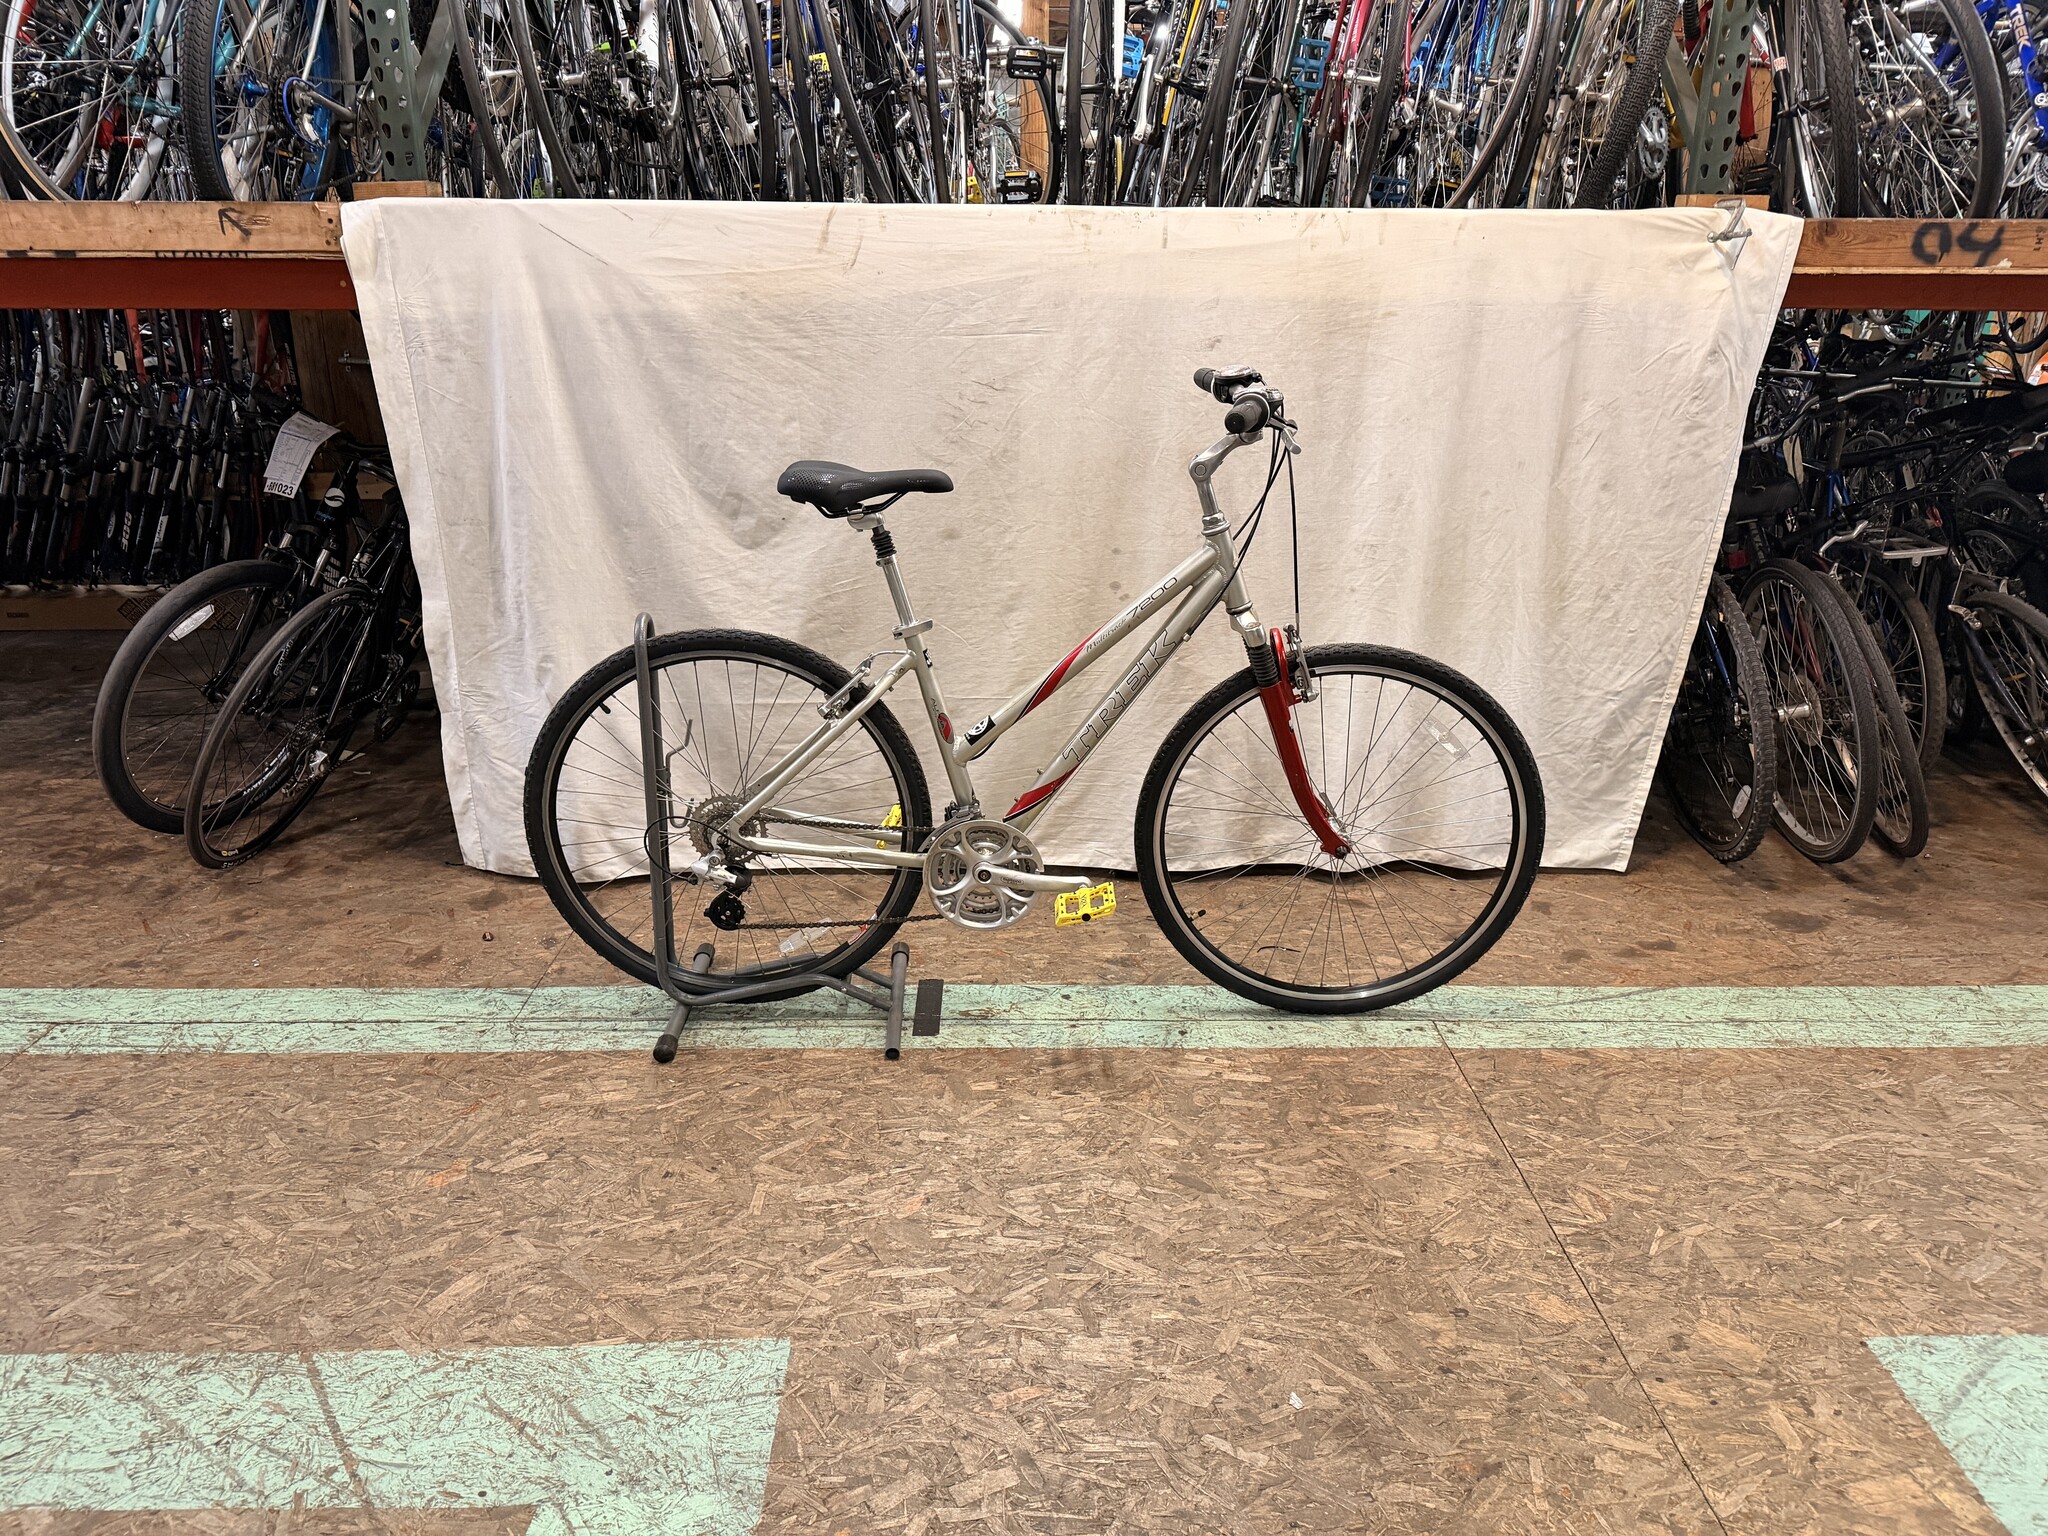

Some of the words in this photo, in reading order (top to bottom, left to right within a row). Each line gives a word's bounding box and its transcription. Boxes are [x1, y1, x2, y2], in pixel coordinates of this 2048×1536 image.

[2009, 3, 2032, 52] TREK
[1125, 576, 1178, 618] 7200
[1062, 628, 1177, 762] TREK
